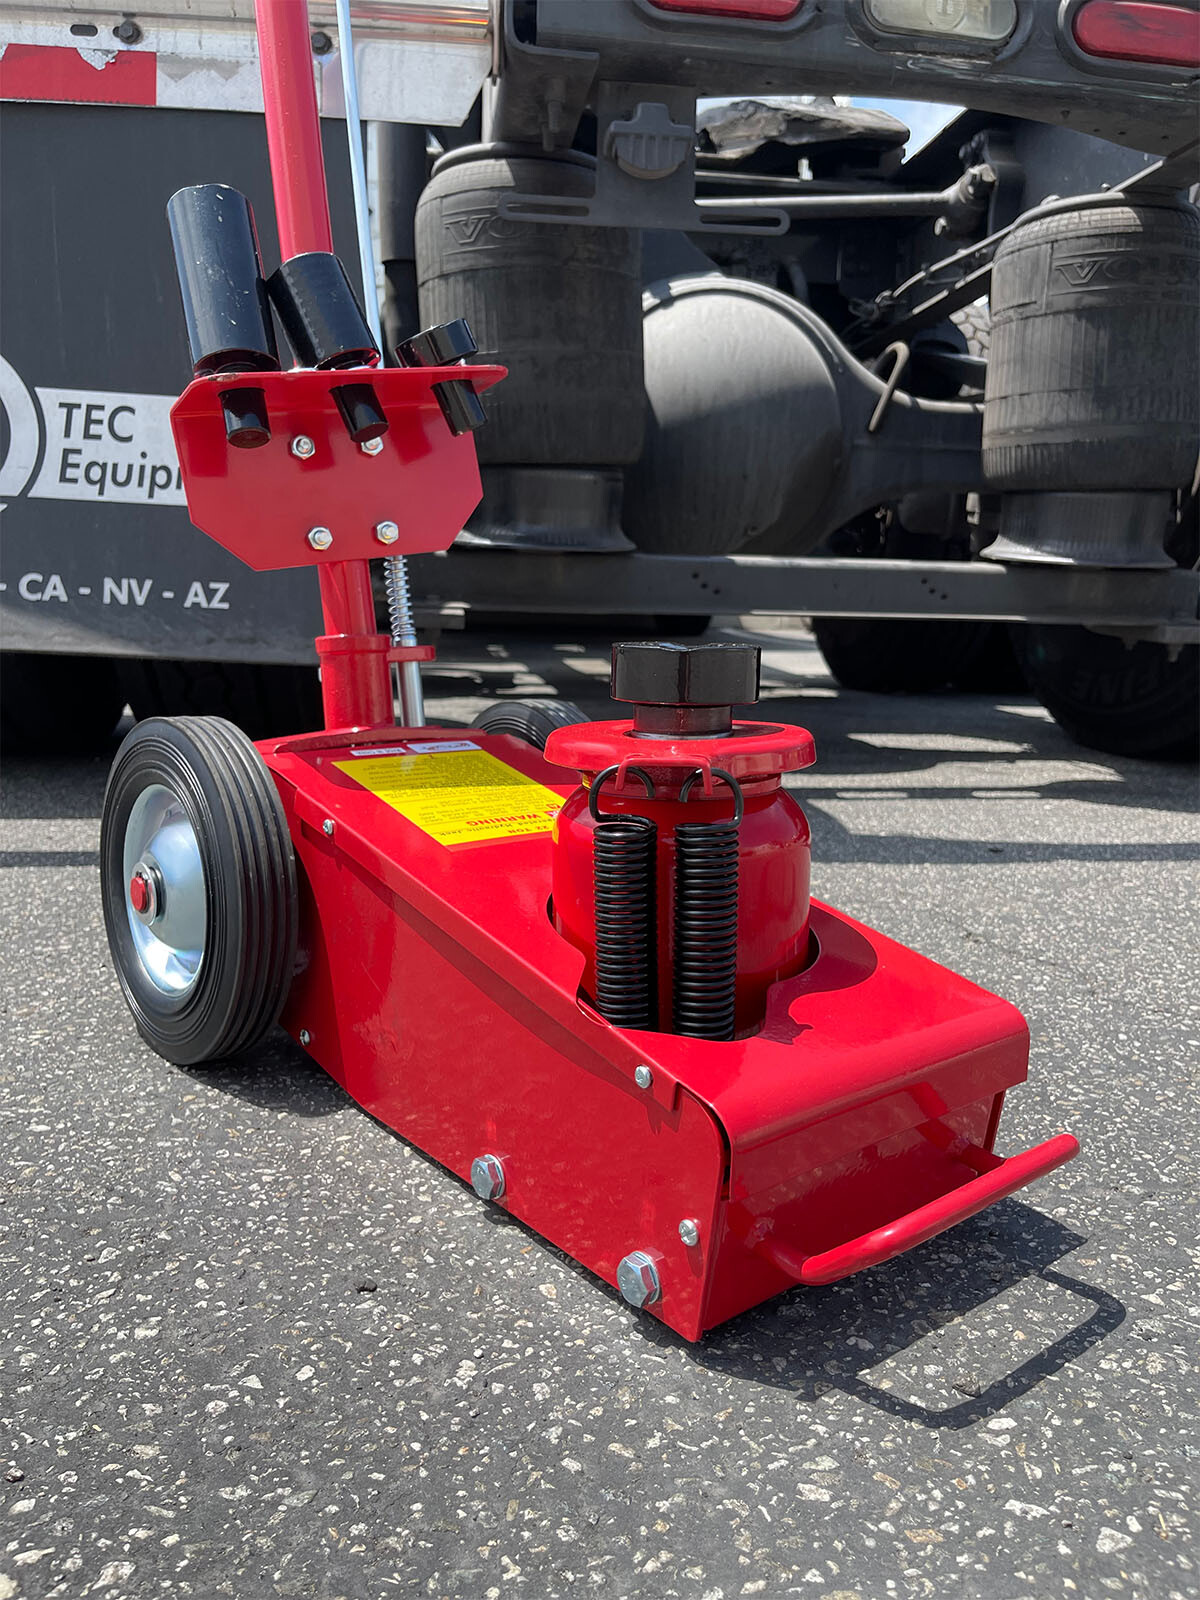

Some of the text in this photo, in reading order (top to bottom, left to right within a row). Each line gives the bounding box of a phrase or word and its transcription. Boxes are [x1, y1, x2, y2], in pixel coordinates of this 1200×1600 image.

[58, 402, 136, 443] TEC
[58, 447, 184, 499] Equip
[18, 572, 69, 603] CA
[103, 577, 153, 606] NV
[183, 581, 230, 610] AZ
[466, 814, 542, 826] WARNING
